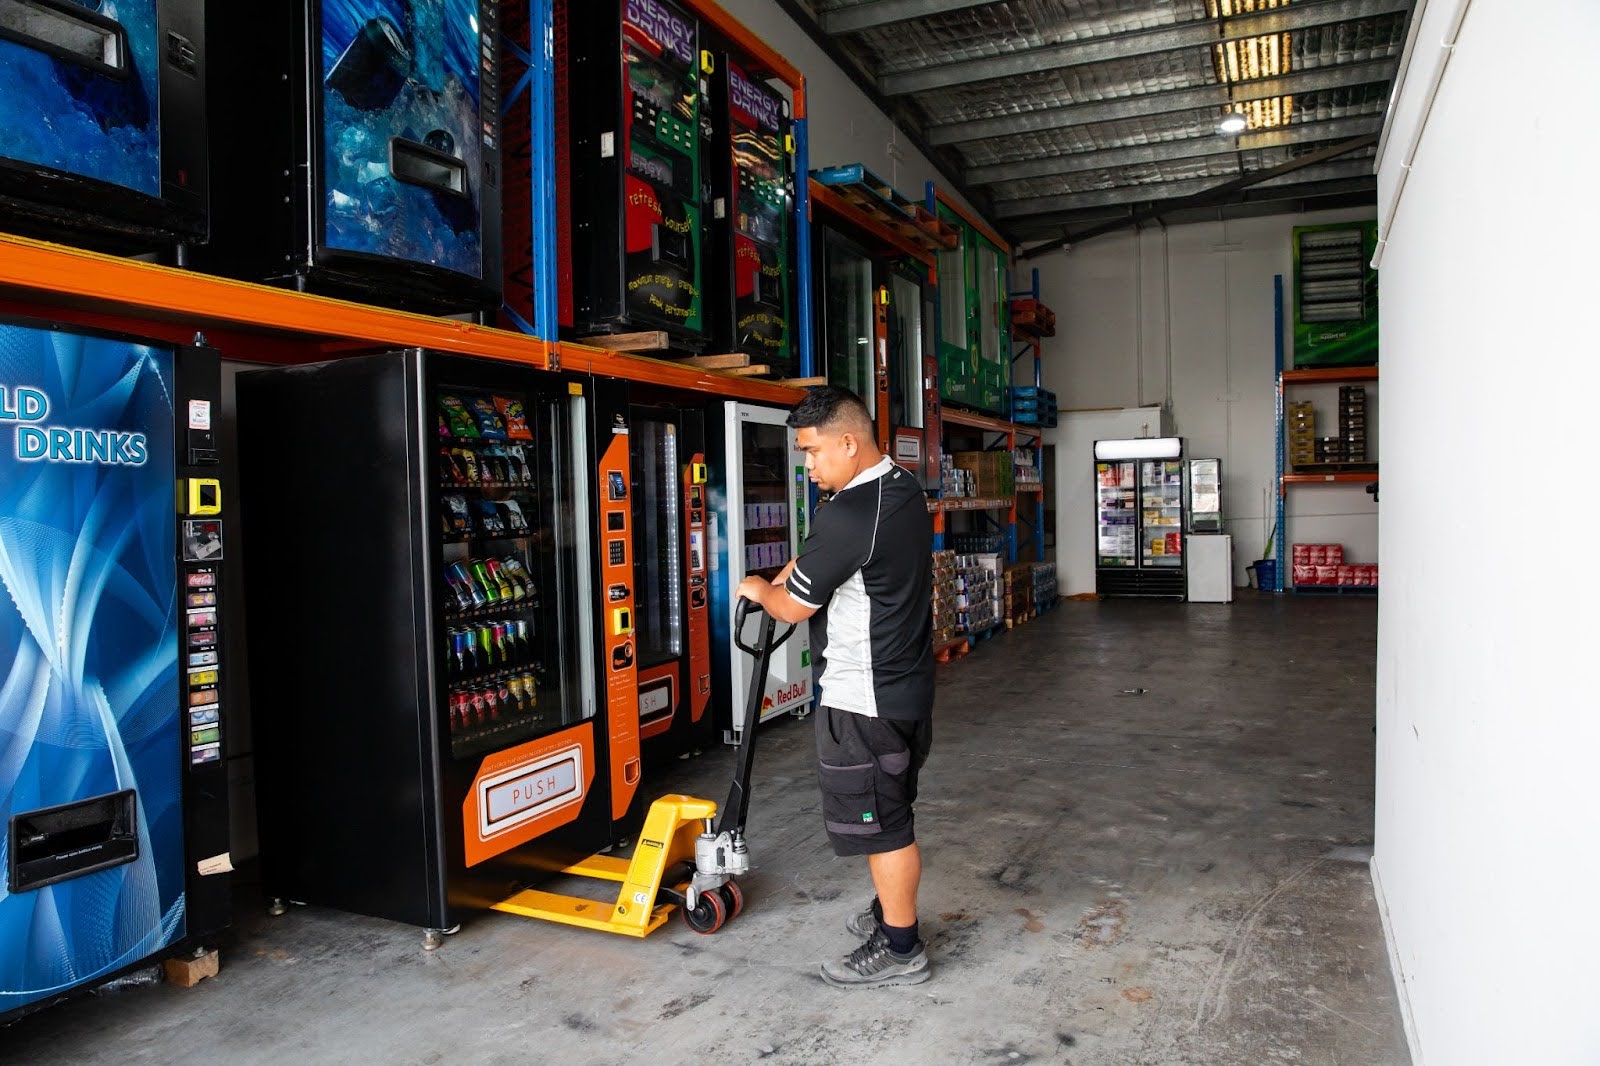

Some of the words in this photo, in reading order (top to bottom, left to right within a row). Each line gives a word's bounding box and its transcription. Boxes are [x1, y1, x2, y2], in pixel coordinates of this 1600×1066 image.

[627, 3, 692, 62] DRINKS
[730, 71, 779, 115] ENERGY
[733, 89, 779, 131] DRINKS
[629, 188, 662, 216] refresh
[18, 427, 147, 464] DRINKS
[777, 684, 792, 706] Red
[792, 678, 807, 699] Bull
[513, 775, 556, 804] PUSH
[635, 893, 646, 904] CE
